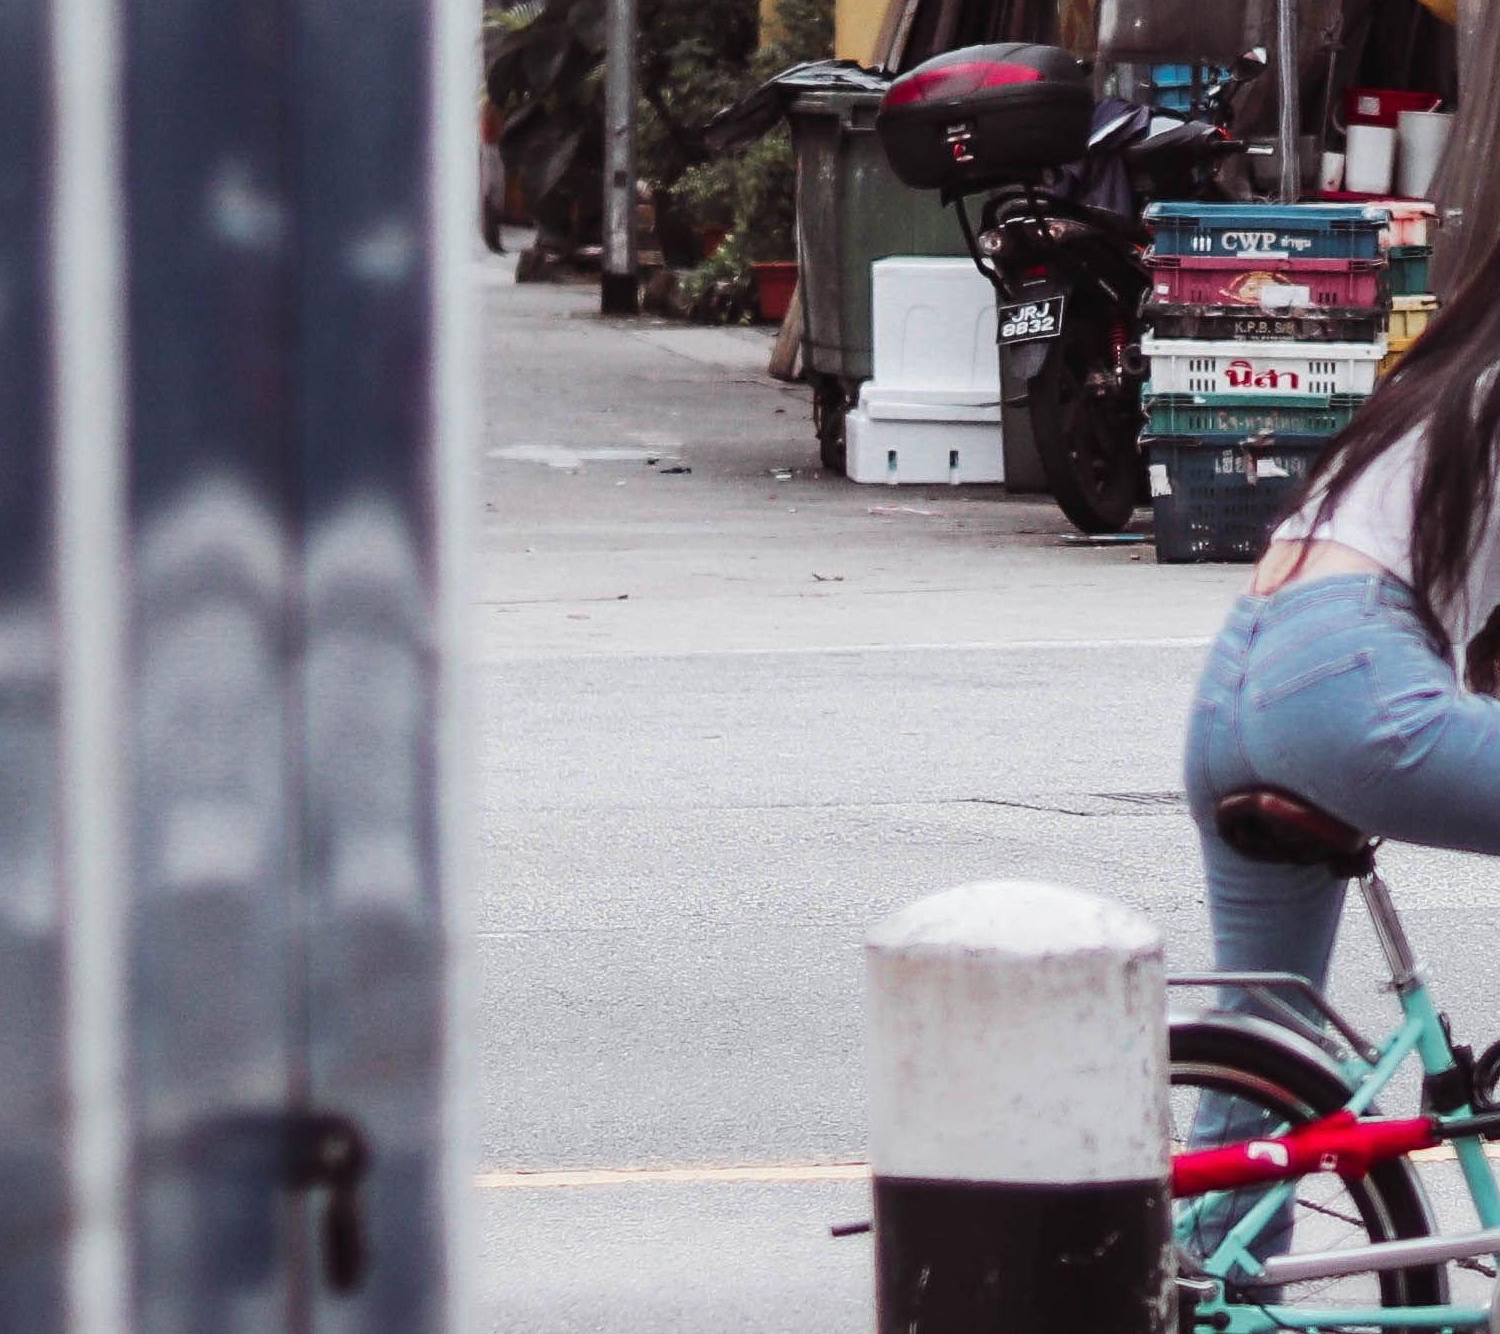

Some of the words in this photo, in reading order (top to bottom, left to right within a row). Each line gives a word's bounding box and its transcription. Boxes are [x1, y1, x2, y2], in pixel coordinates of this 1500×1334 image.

[1221, 231, 1277, 252] CWP
[1011, 302, 1050, 323] JRJ
[1002, 316, 1055, 337] 8832
